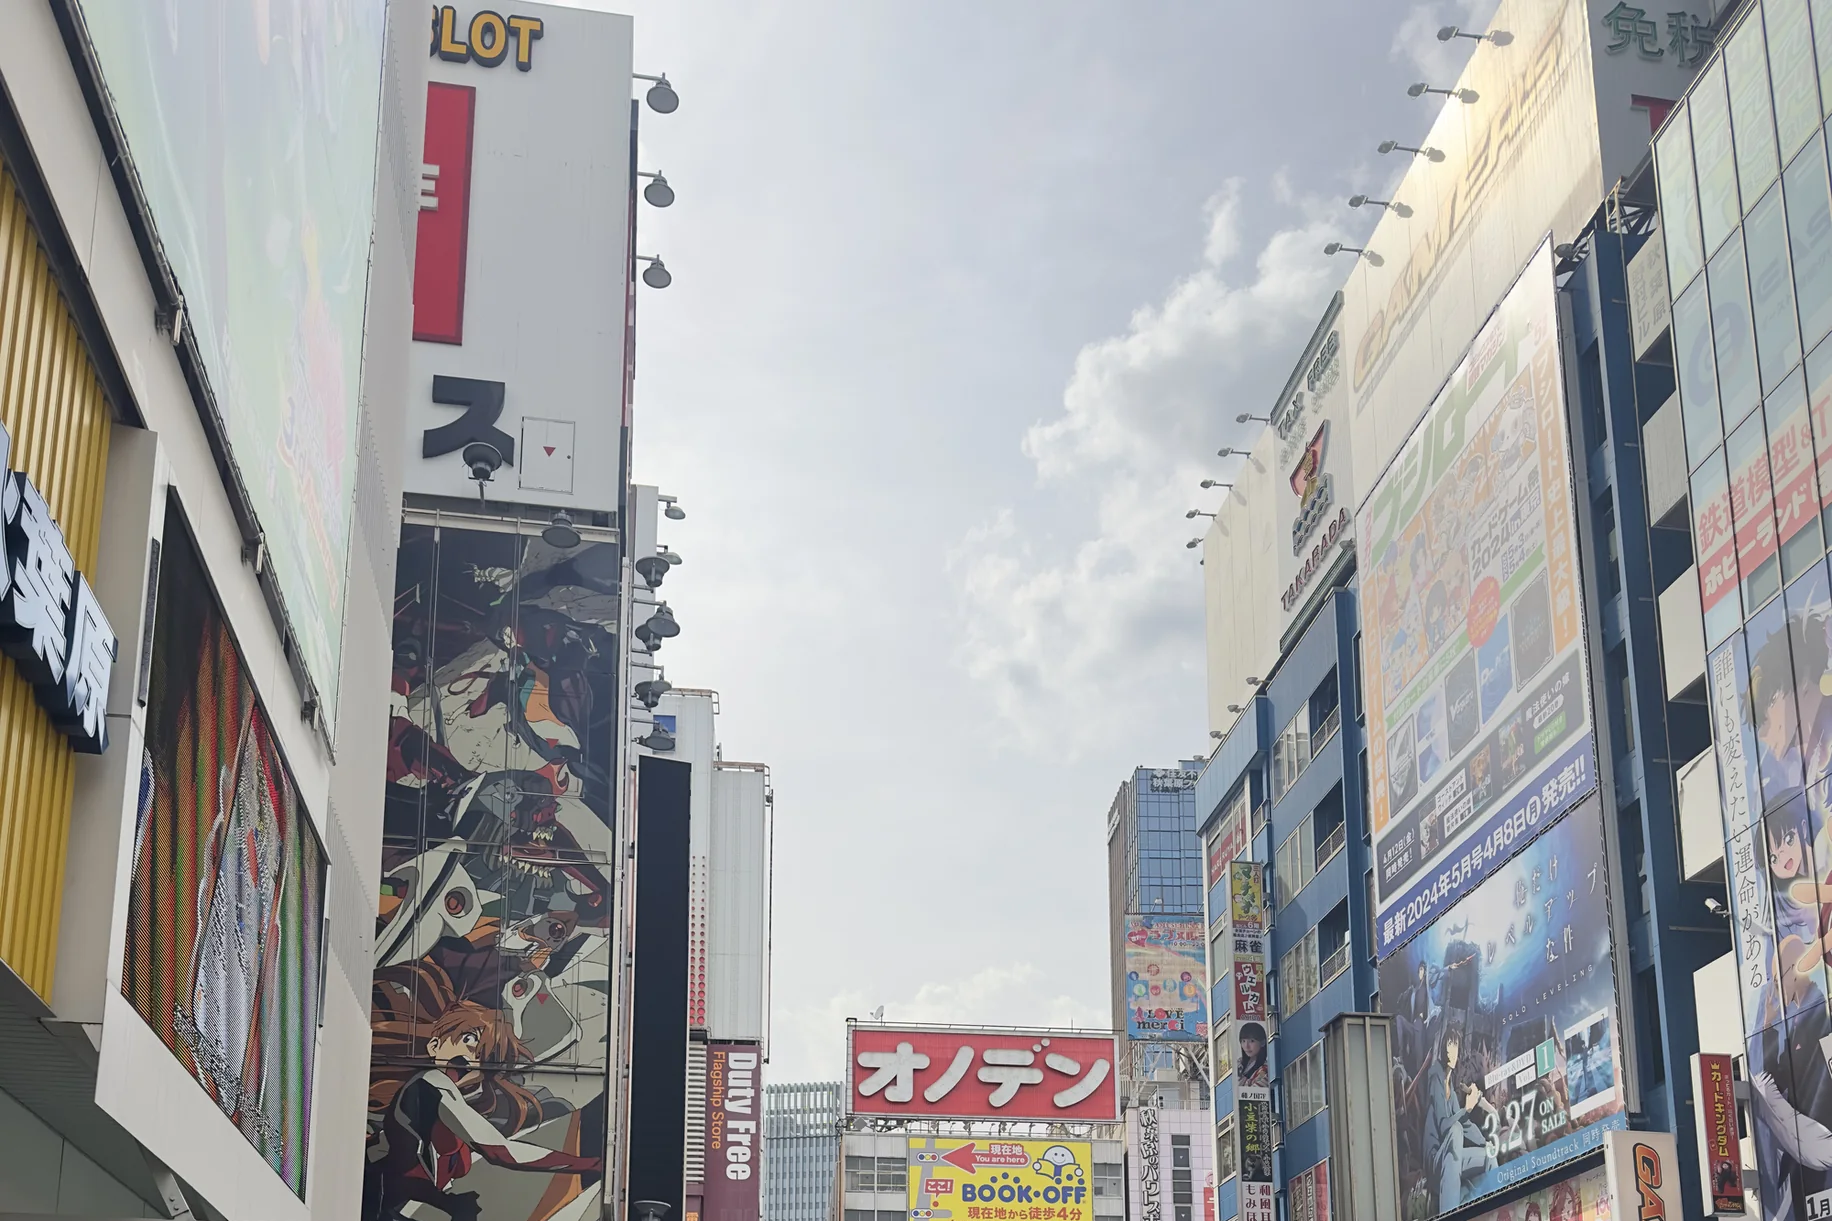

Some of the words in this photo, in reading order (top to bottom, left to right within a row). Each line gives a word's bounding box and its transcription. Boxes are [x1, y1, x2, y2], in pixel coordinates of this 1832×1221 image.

[430, 3, 543, 72] LOT
[1278, 391, 1304, 441] TAX
[1307, 330, 1339, 392] FREE
[1281, 507, 1350, 613] TAKARADA
[1234, 939, 1263, 955] 麻雀
[1501, 1005, 1527, 1025] SOLO
[1534, 964, 1594, 1005] LEVELING
[709, 1051, 726, 1108] Flagship
[725, 1052, 758, 1114] Duty
[857, 1038, 1111, 1108] オノデン
[711, 1111, 725, 1150] Store
[1483, 1090, 1538, 1160] 3.27
[1538, 1096, 1555, 1116] ON
[1541, 1110, 1567, 1134] SALE
[725, 1120, 758, 1181] Free
[975, 1155, 991, 1163] You
[990, 1143, 1023, 1156] 現在地
[1496, 1161, 1531, 1185] Original
[1531, 1140, 1580, 1173] Soundtrack
[926, 1181, 952, 1192] ここ!
[967, 1206, 1083, 1221] 現在地から徒歩4分
